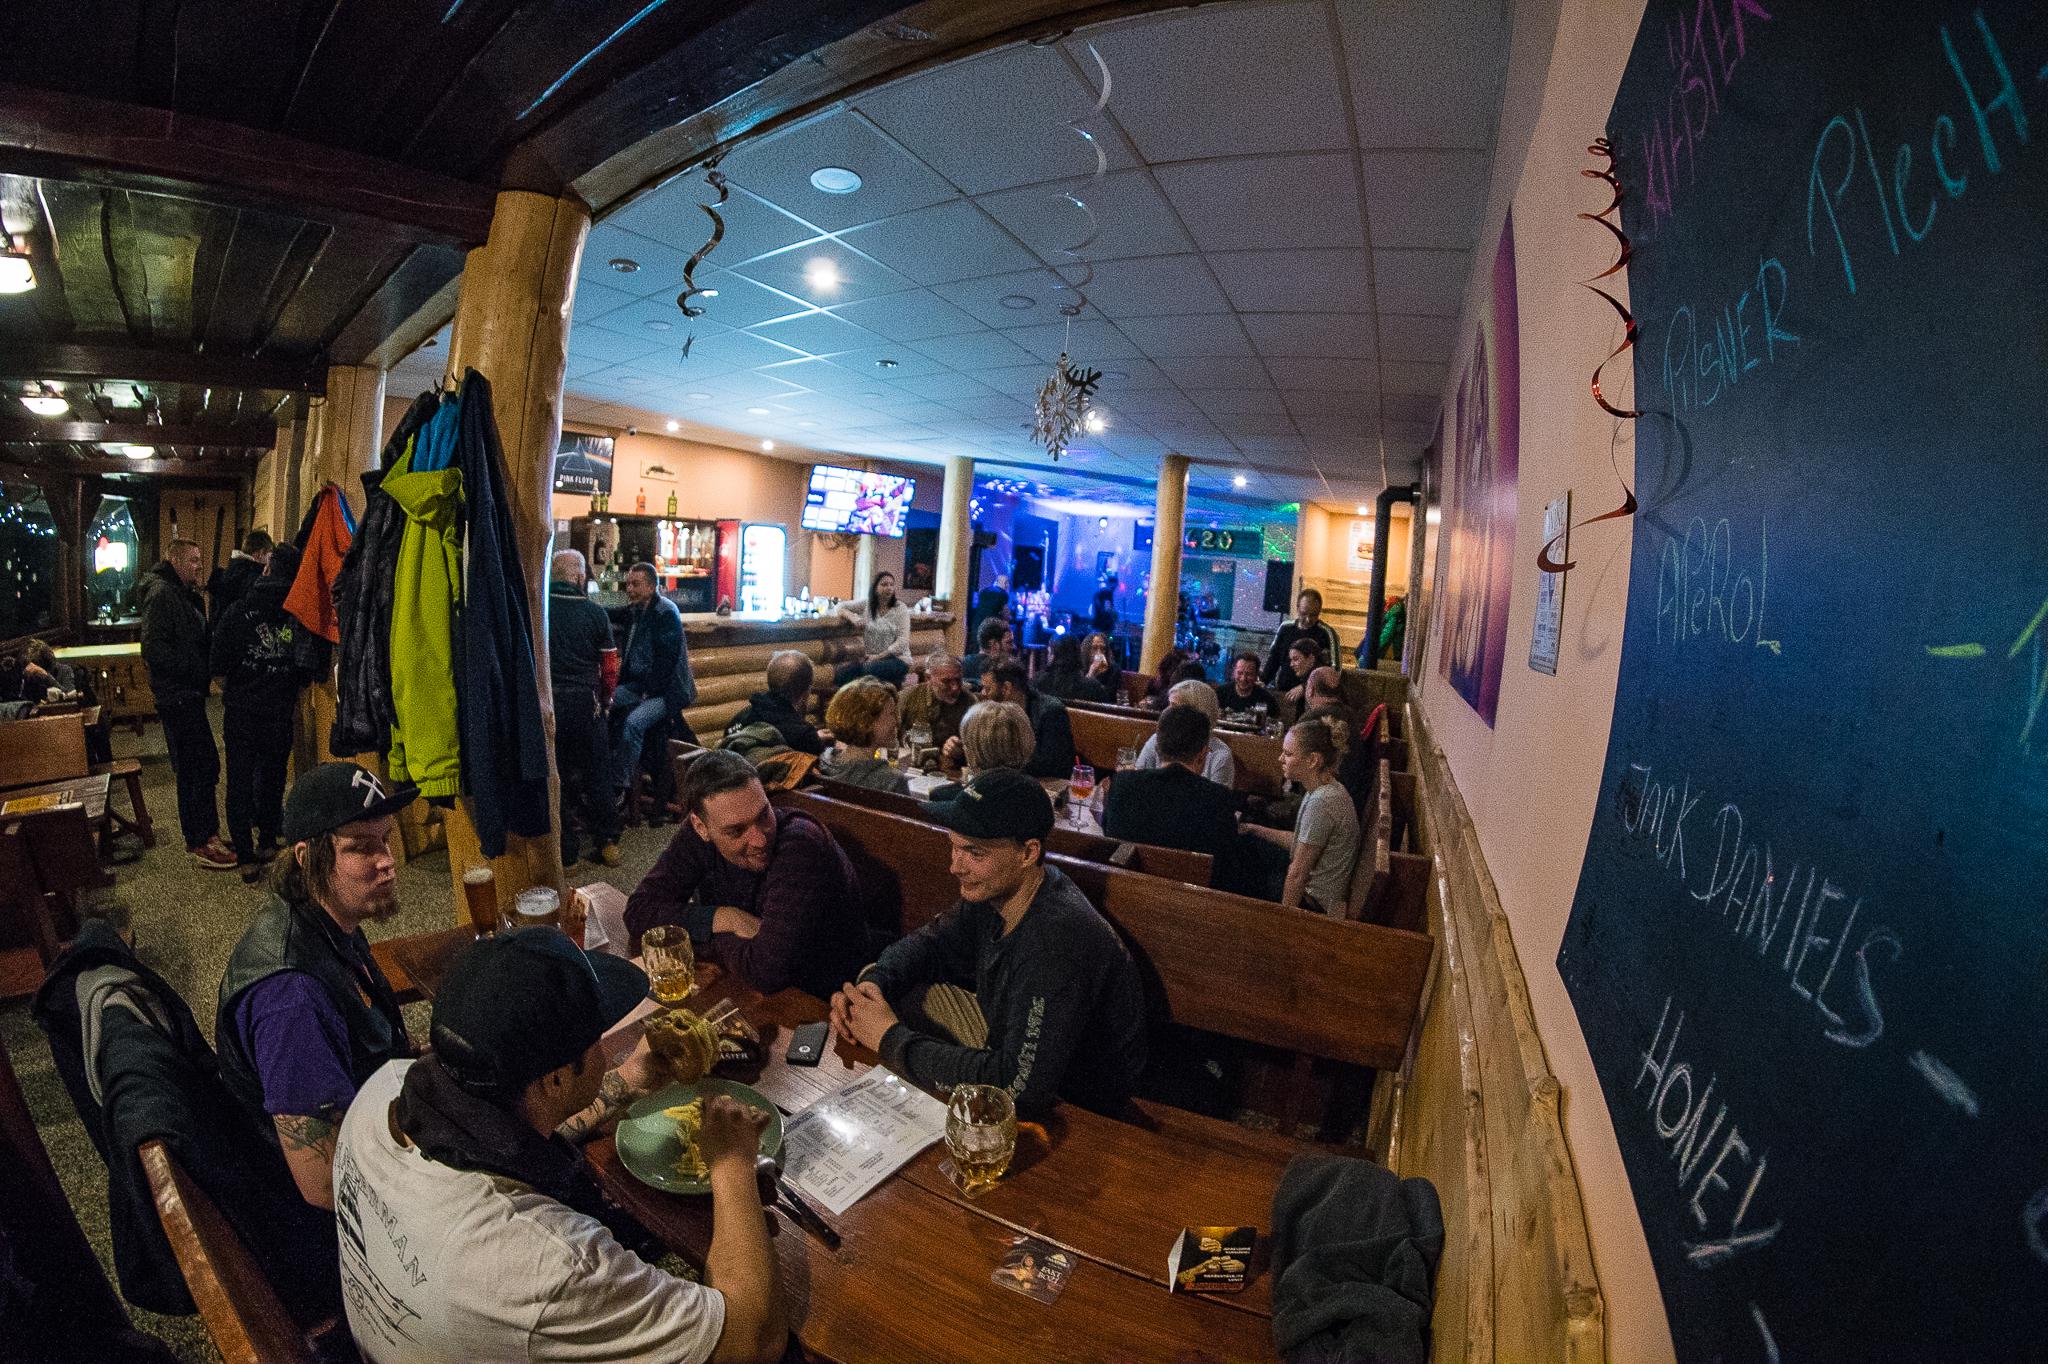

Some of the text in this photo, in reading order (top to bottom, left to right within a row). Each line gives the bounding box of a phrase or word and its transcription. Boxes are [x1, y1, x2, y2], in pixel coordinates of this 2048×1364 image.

[560, 474, 594, 485] PINK FLOYD
[1625, 762, 1902, 1046] JACK DANIELS
